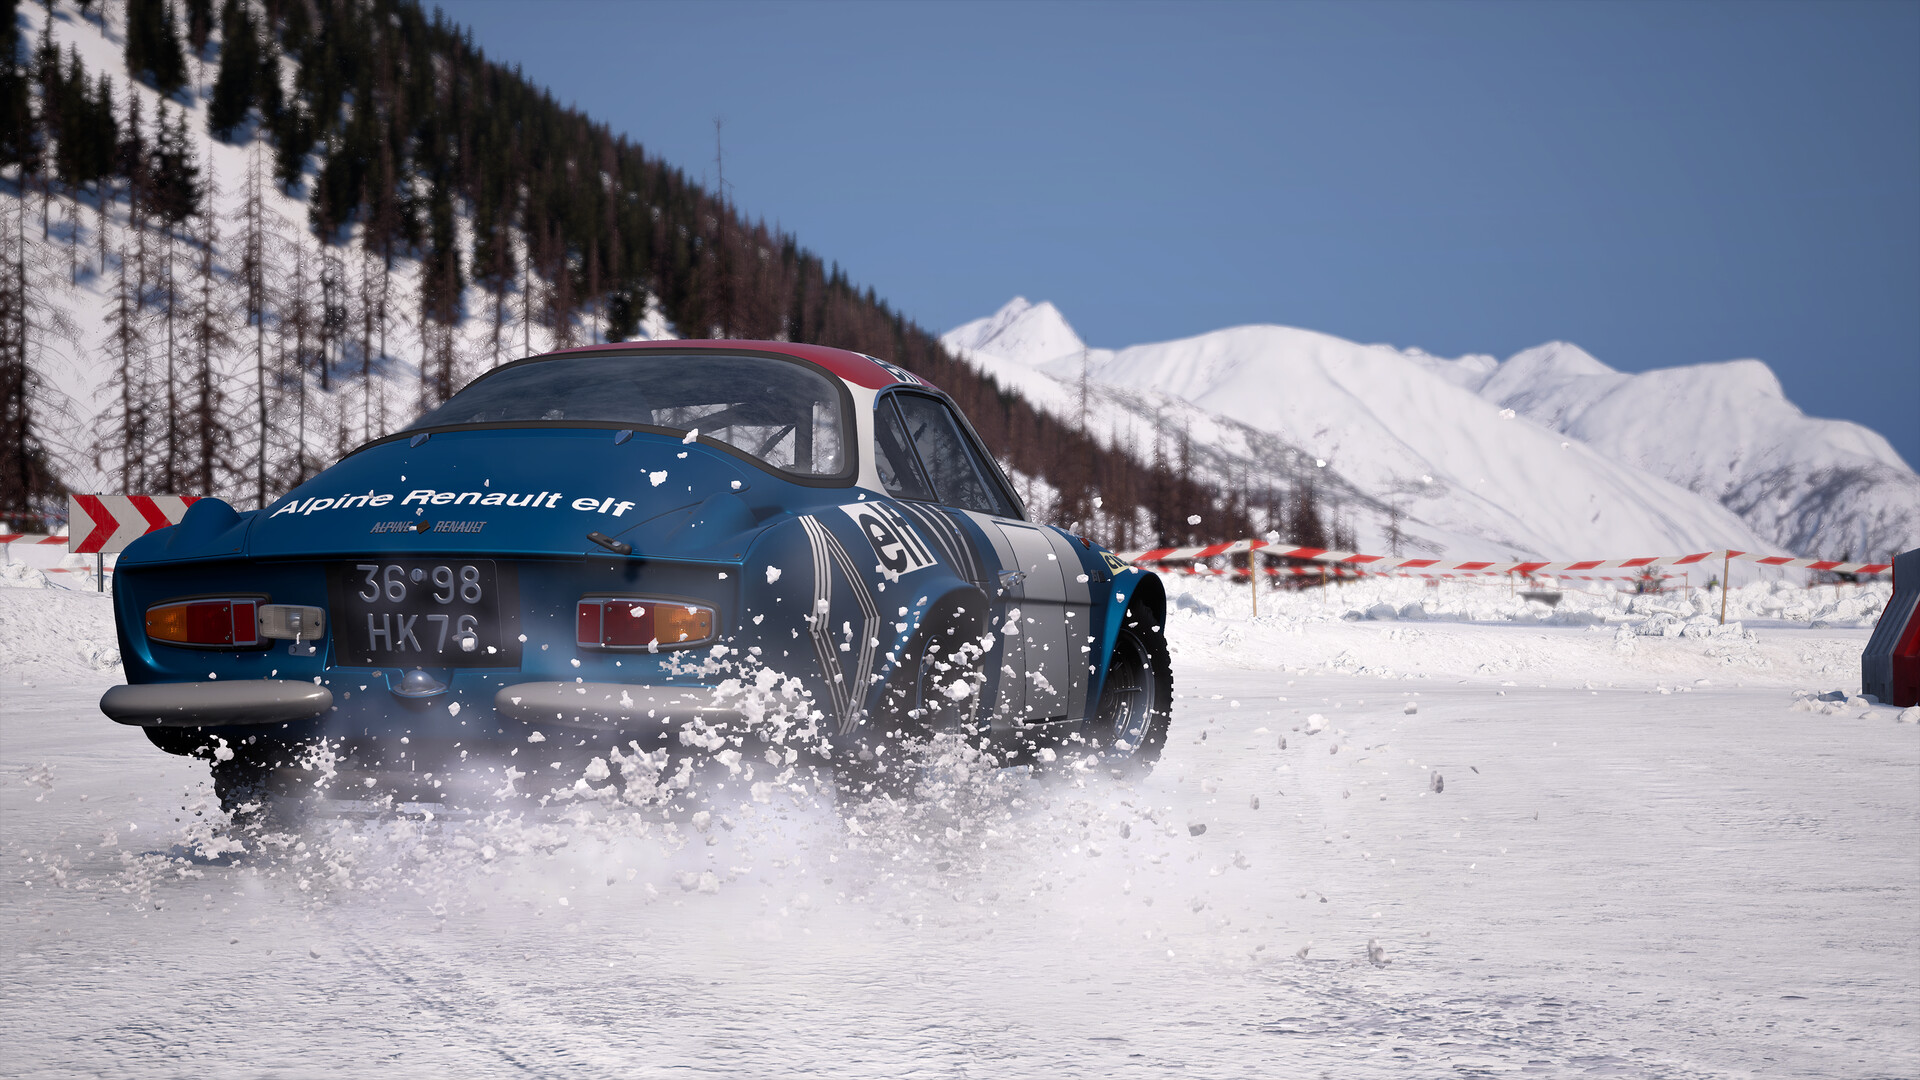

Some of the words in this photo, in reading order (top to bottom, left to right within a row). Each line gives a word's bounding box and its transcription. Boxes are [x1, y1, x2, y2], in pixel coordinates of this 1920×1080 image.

[269, 493, 394, 519] Alpine
[400, 489, 562, 509] Renault
[571, 496, 636, 518] elf
[369, 521, 413, 533] ALPINE
[433, 520, 488, 533] RENAULT
[367, 612, 479, 653] HK76
